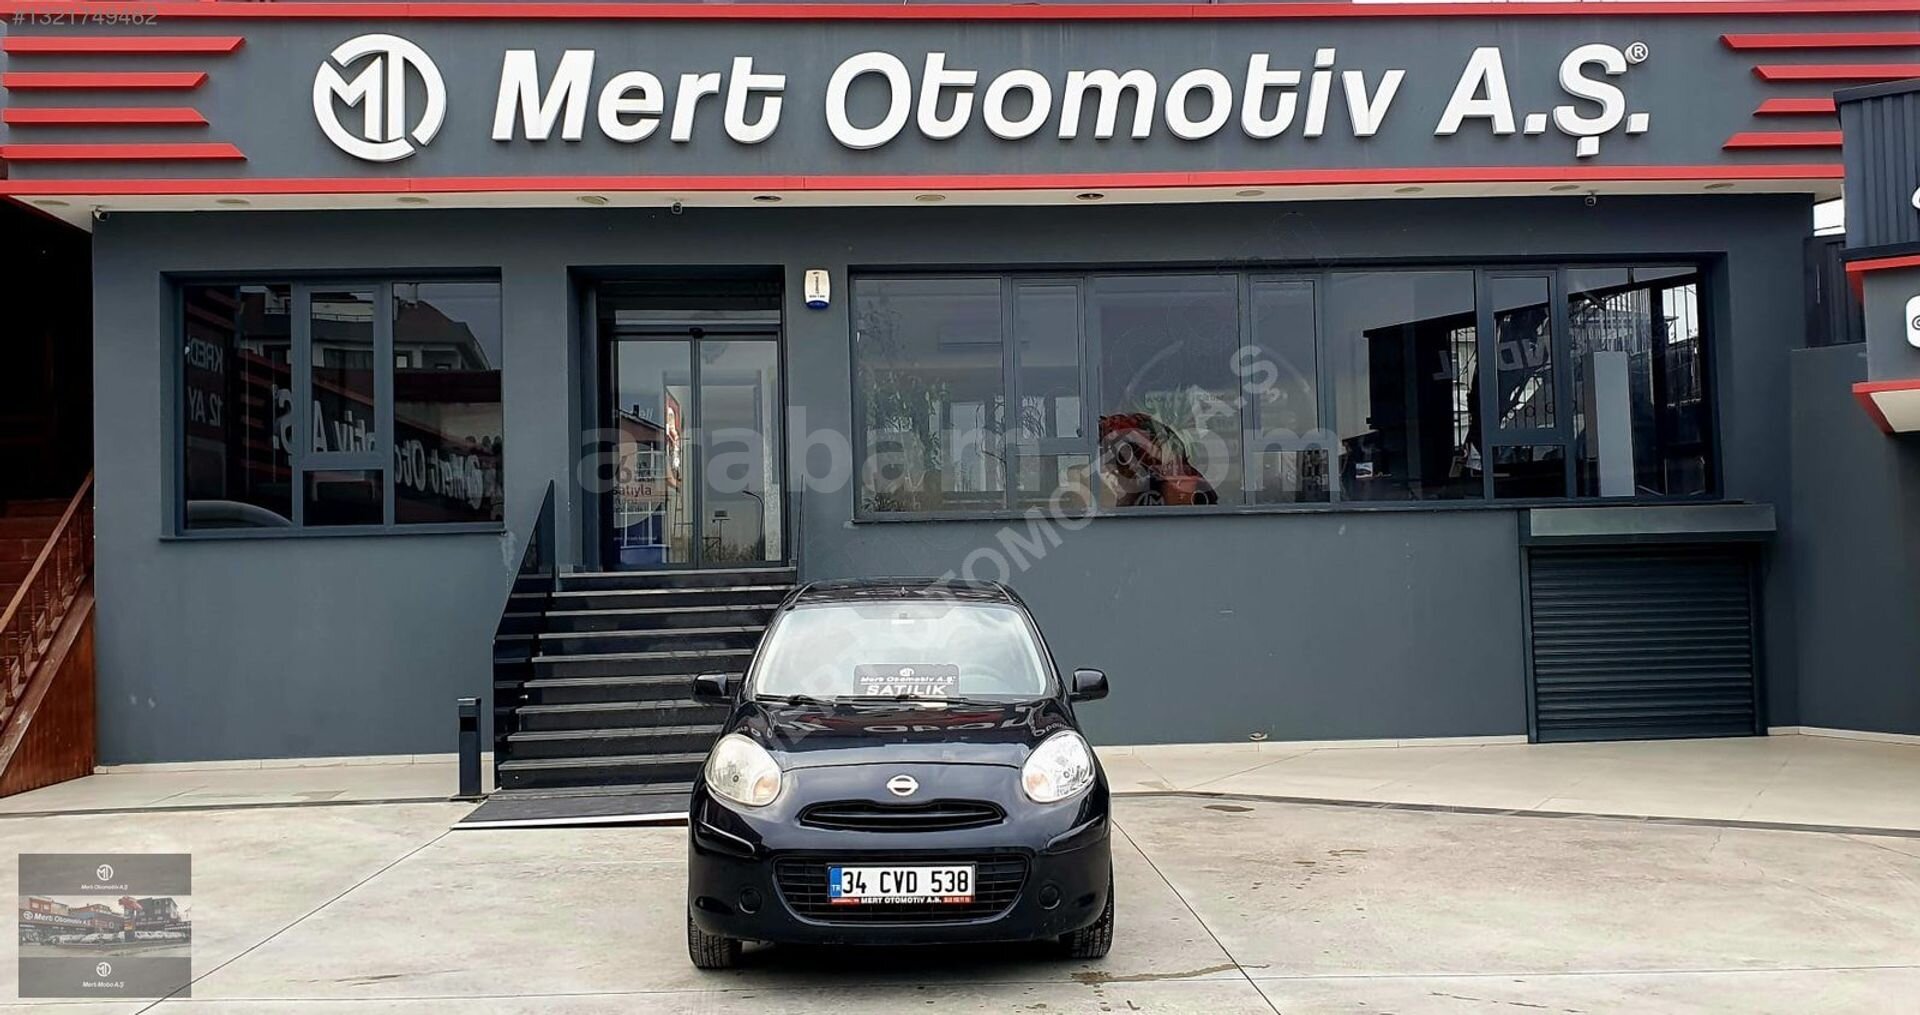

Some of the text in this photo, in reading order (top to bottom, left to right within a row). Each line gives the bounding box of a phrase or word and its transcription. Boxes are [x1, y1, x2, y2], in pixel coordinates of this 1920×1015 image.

[492, 49, 787, 145] Mert
[825, 47, 1406, 150] Otomotiv
[866, 685, 947, 696] SATILIK
[842, 870, 968, 894] 34 CVD 538
